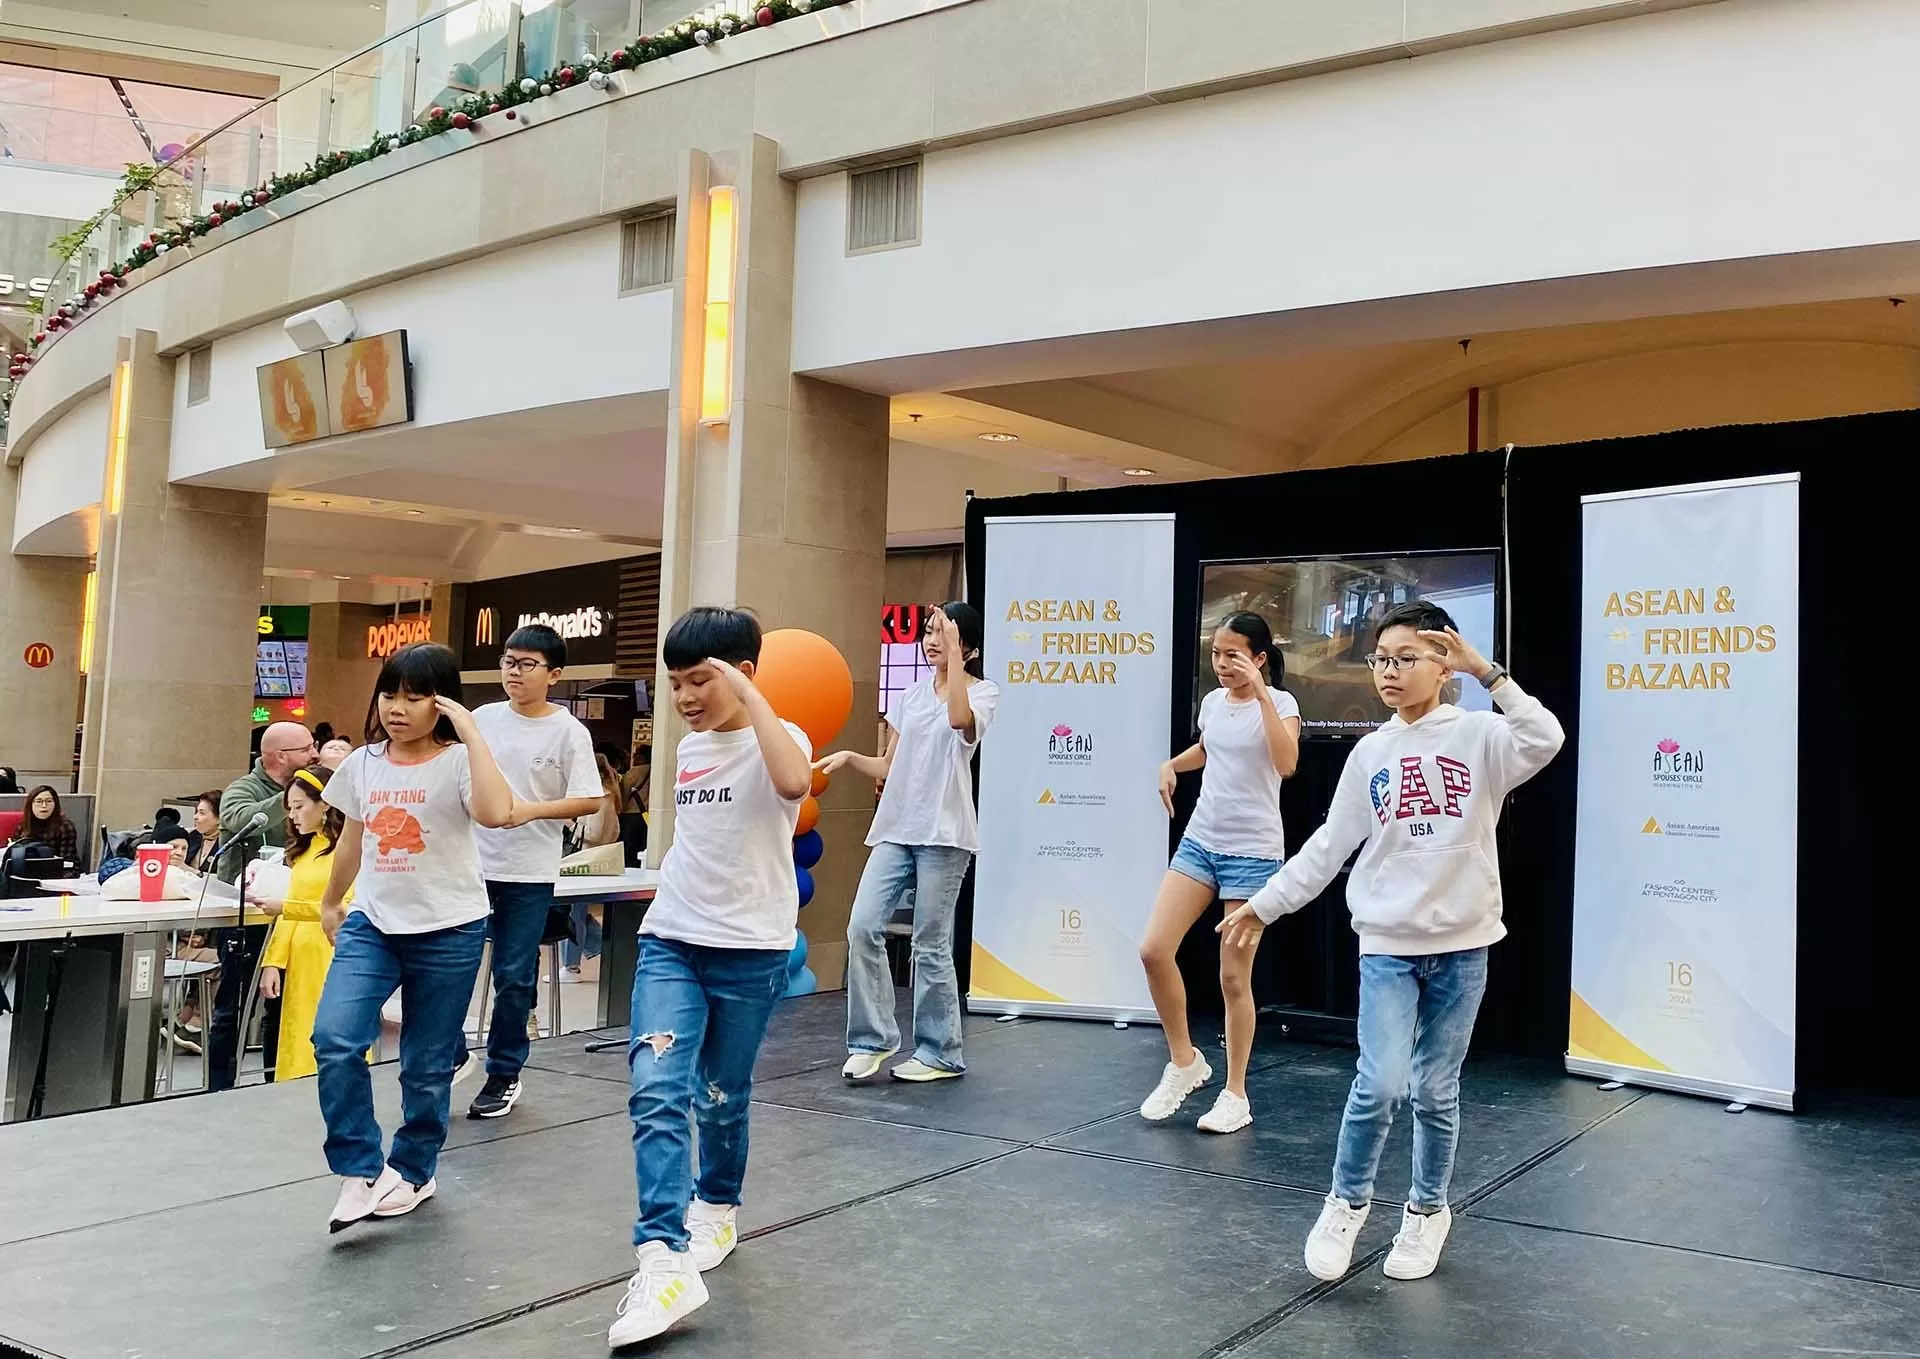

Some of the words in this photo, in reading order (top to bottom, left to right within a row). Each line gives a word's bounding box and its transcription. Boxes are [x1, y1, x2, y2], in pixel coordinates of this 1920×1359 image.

[1006, 600, 1095, 622] ASEAN
[1103, 600, 1121, 622] &
[1604, 588, 1704, 617] ASEAN
[1714, 586, 1735, 613] &
[1041, 632, 1155, 655] FRIENDS
[1643, 625, 1777, 655] FRIENDS
[1008, 661, 1116, 684] BAZAAR
[1606, 662, 1731, 690] BAZAAR
[1048, 733, 1093, 753] ASEAN
[1653, 750, 1704, 774] ASEAN
[1682, 775, 1703, 783] CIRCLE
[698, 788, 715, 804] DO
[718, 786, 732, 802] IT.
[1370, 755, 1472, 826] GAP
[1409, 822, 1434, 837] USA
[1666, 821, 1686, 830] Asian
[1688, 823, 1720, 831] American
[1644, 883, 1679, 893] FASHION
[1681, 887, 1715, 896] CENTRE
[1652, 891, 1698, 901] PENTAGON
[1060, 909, 1081, 929] 16
[1667, 961, 1692, 986] 16
